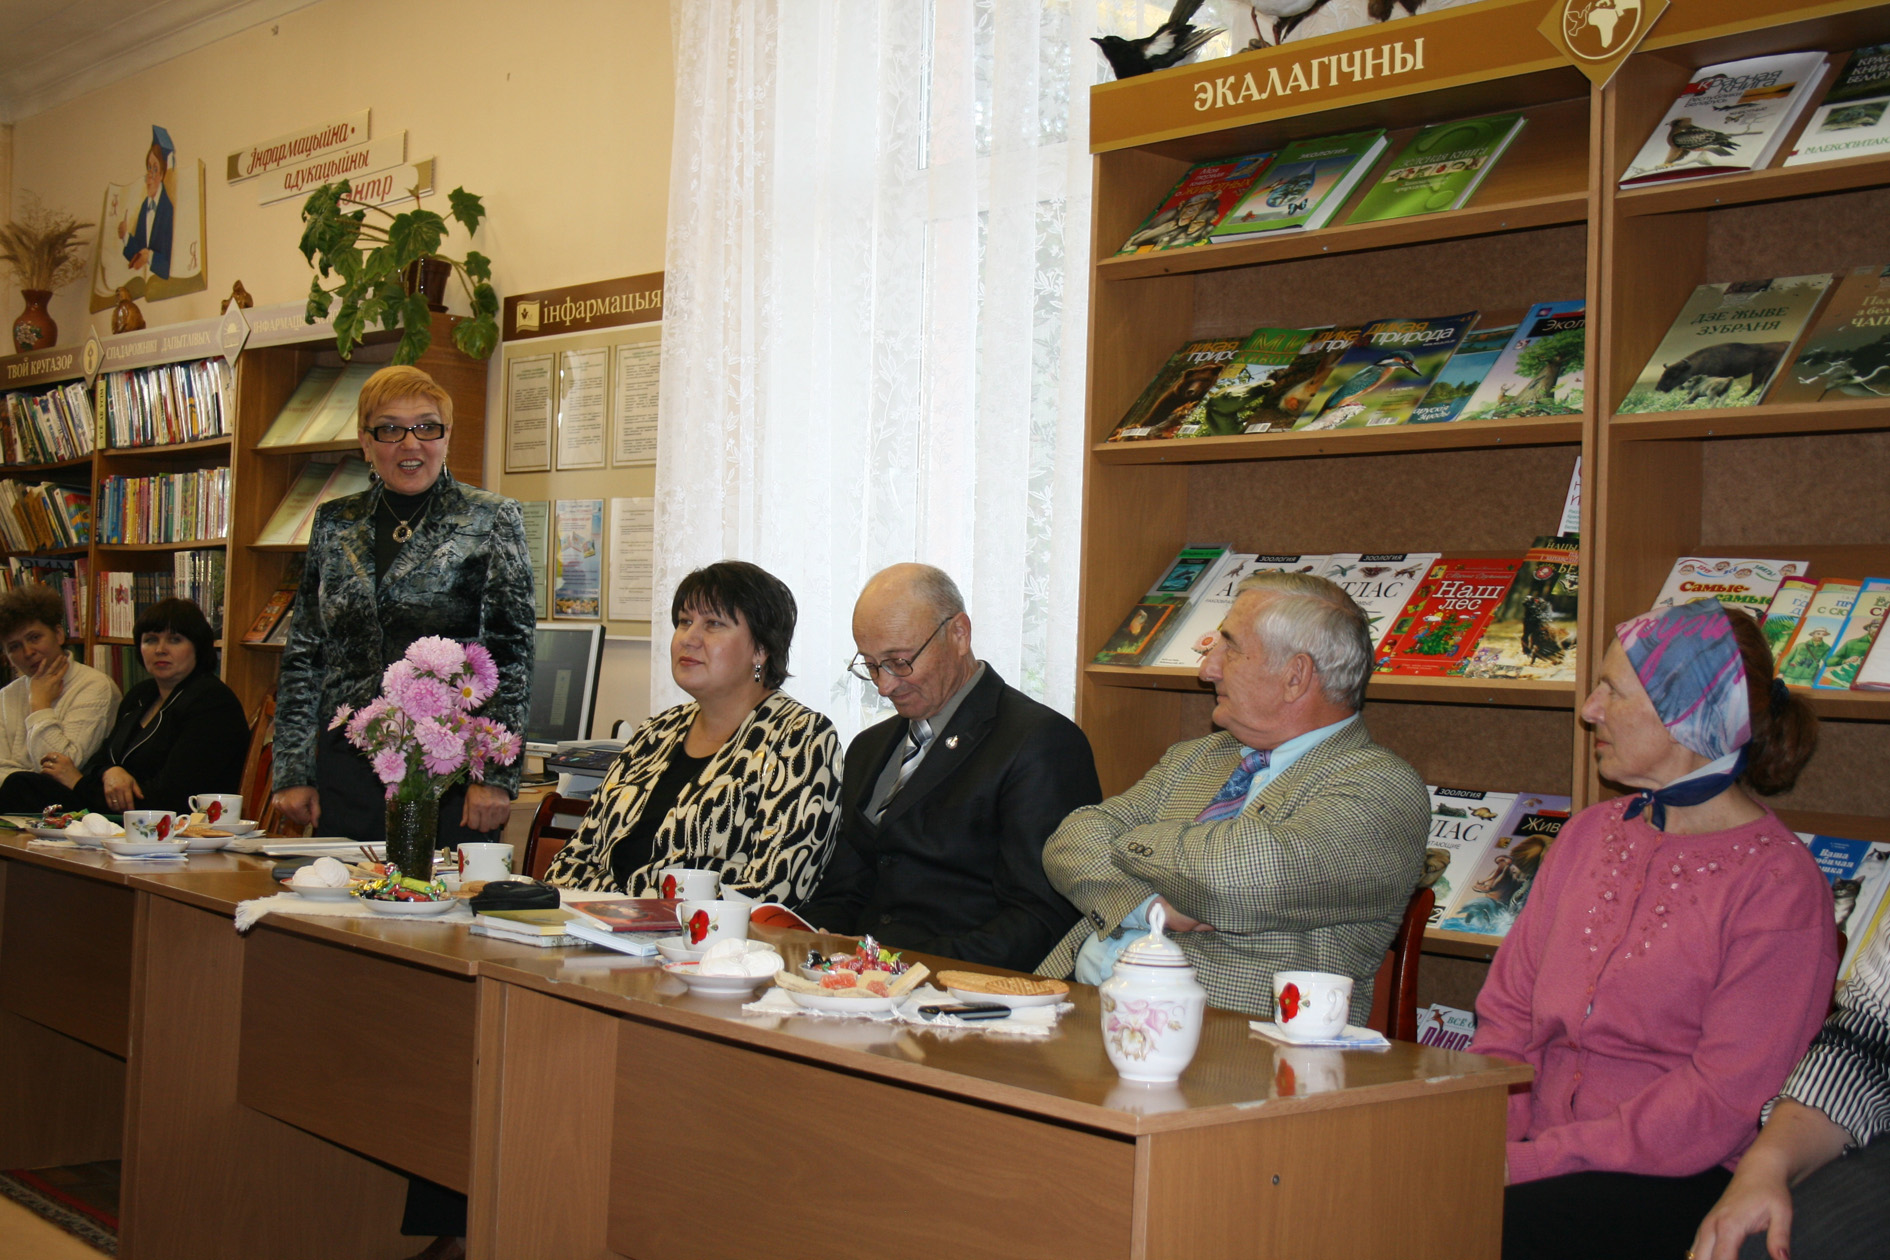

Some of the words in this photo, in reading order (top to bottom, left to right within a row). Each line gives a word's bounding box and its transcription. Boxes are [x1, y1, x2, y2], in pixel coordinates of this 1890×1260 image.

[1193, 38, 1425, 112] ЭКАЛАГІЧНЫ
[1851, 63, 1890, 76] КНИГ
[284, 149, 370, 191] адукацыйны
[336, 174, 393, 207] энтр
[543, 288, 663, 327] інфармацыя
[1371, 328, 1455, 345] природа
[7, 356, 30, 379] ТВОЙ
[30, 354, 73, 375] КРУГАЗОР
[1336, 581, 1404, 598] ТЛАС
[1432, 580, 1505, 599] Наш
[1438, 598, 1482, 611] лес
[1438, 788, 1483, 799] ЗООЛОГИЯ
[1430, 818, 1484, 842] ЛАС
